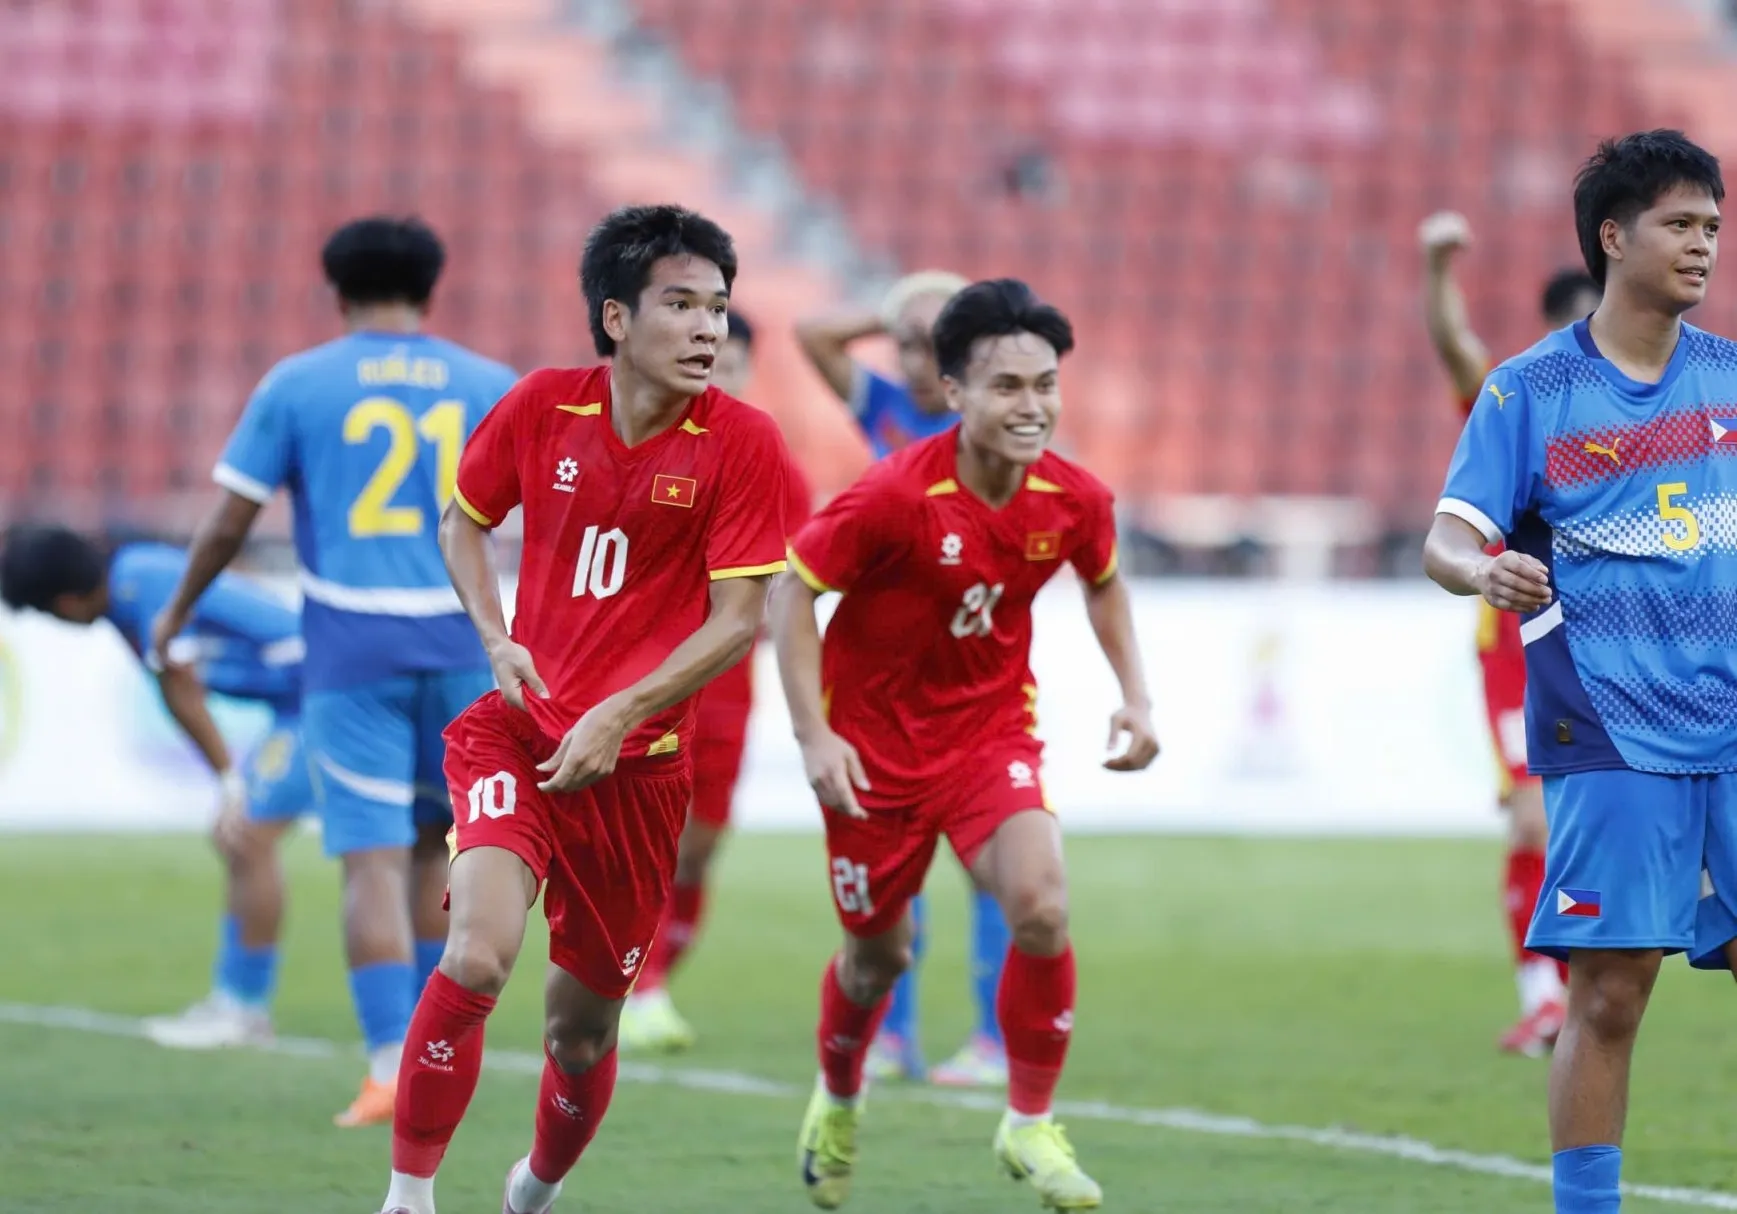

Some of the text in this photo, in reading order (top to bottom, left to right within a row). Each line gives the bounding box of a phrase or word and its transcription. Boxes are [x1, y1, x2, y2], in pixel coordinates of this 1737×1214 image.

[343, 397, 466, 538] 21
[1657, 482, 1700, 551] 5
[572, 525, 629, 600] 10
[949, 582, 1005, 639] 21
[467, 770, 517, 824] 10
[832, 856, 874, 917] 21
